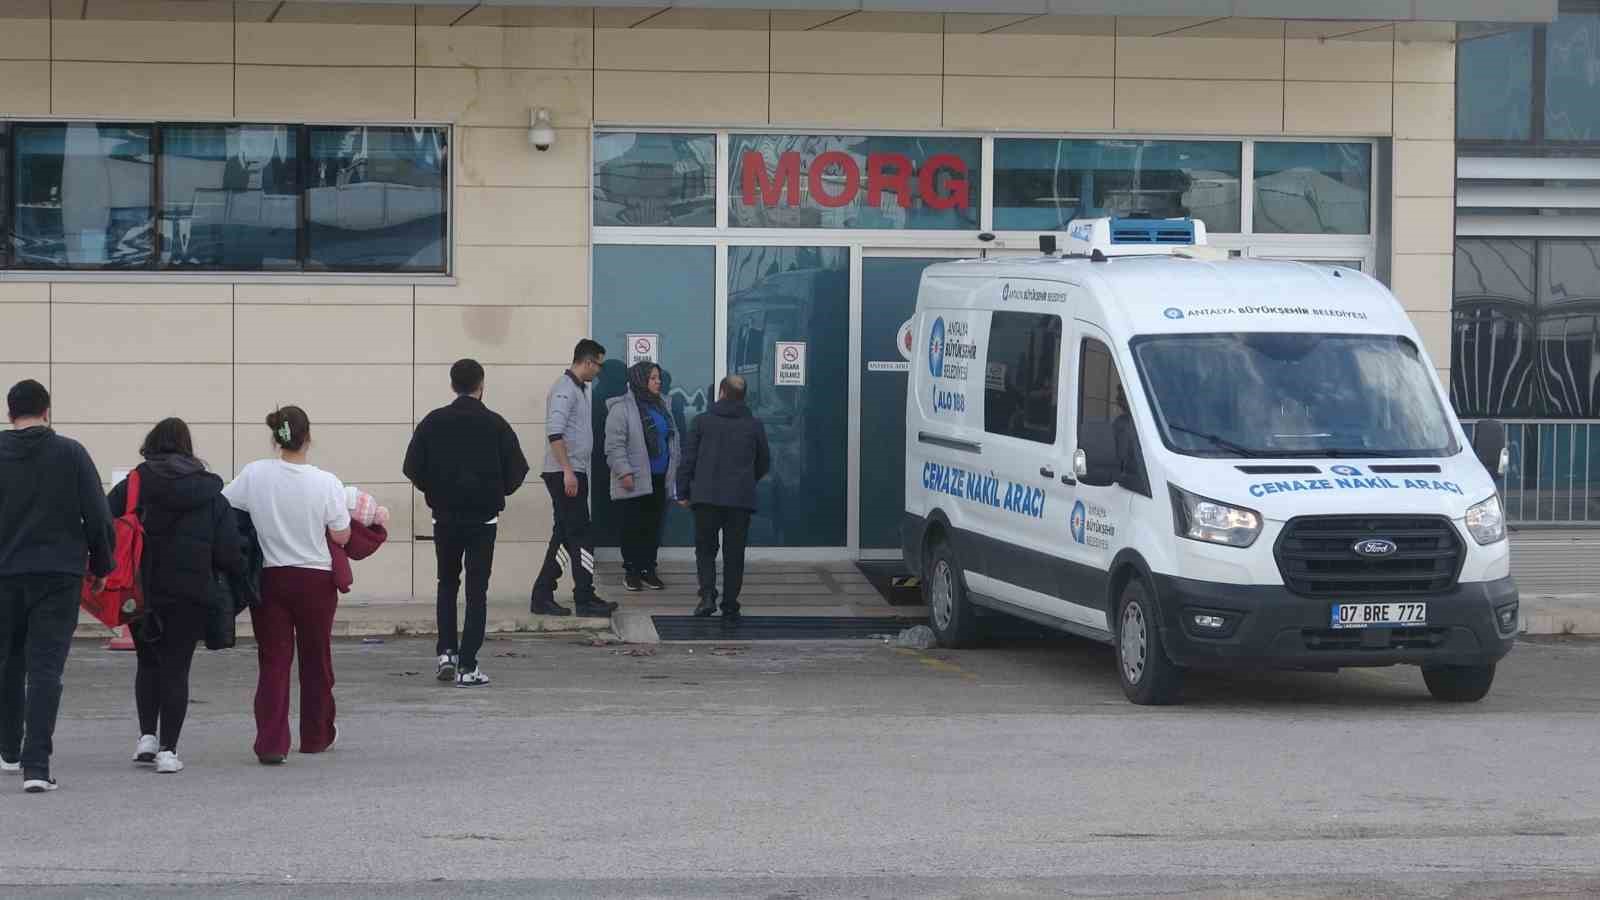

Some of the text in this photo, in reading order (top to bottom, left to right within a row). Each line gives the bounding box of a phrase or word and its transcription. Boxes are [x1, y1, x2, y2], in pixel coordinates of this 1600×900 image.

[741, 150, 970, 209] MORG
[1187, 306, 1235, 317] ANTALYA
[938, 391, 952, 410] ALO
[922, 461, 1046, 519] CENAZE NAKİL ARACI
[1249, 476, 1464, 497] CENAZE NAKİL ARACI
[1364, 542, 1390, 553] Ford
[1340, 604, 1424, 621] 07 BRE 772
